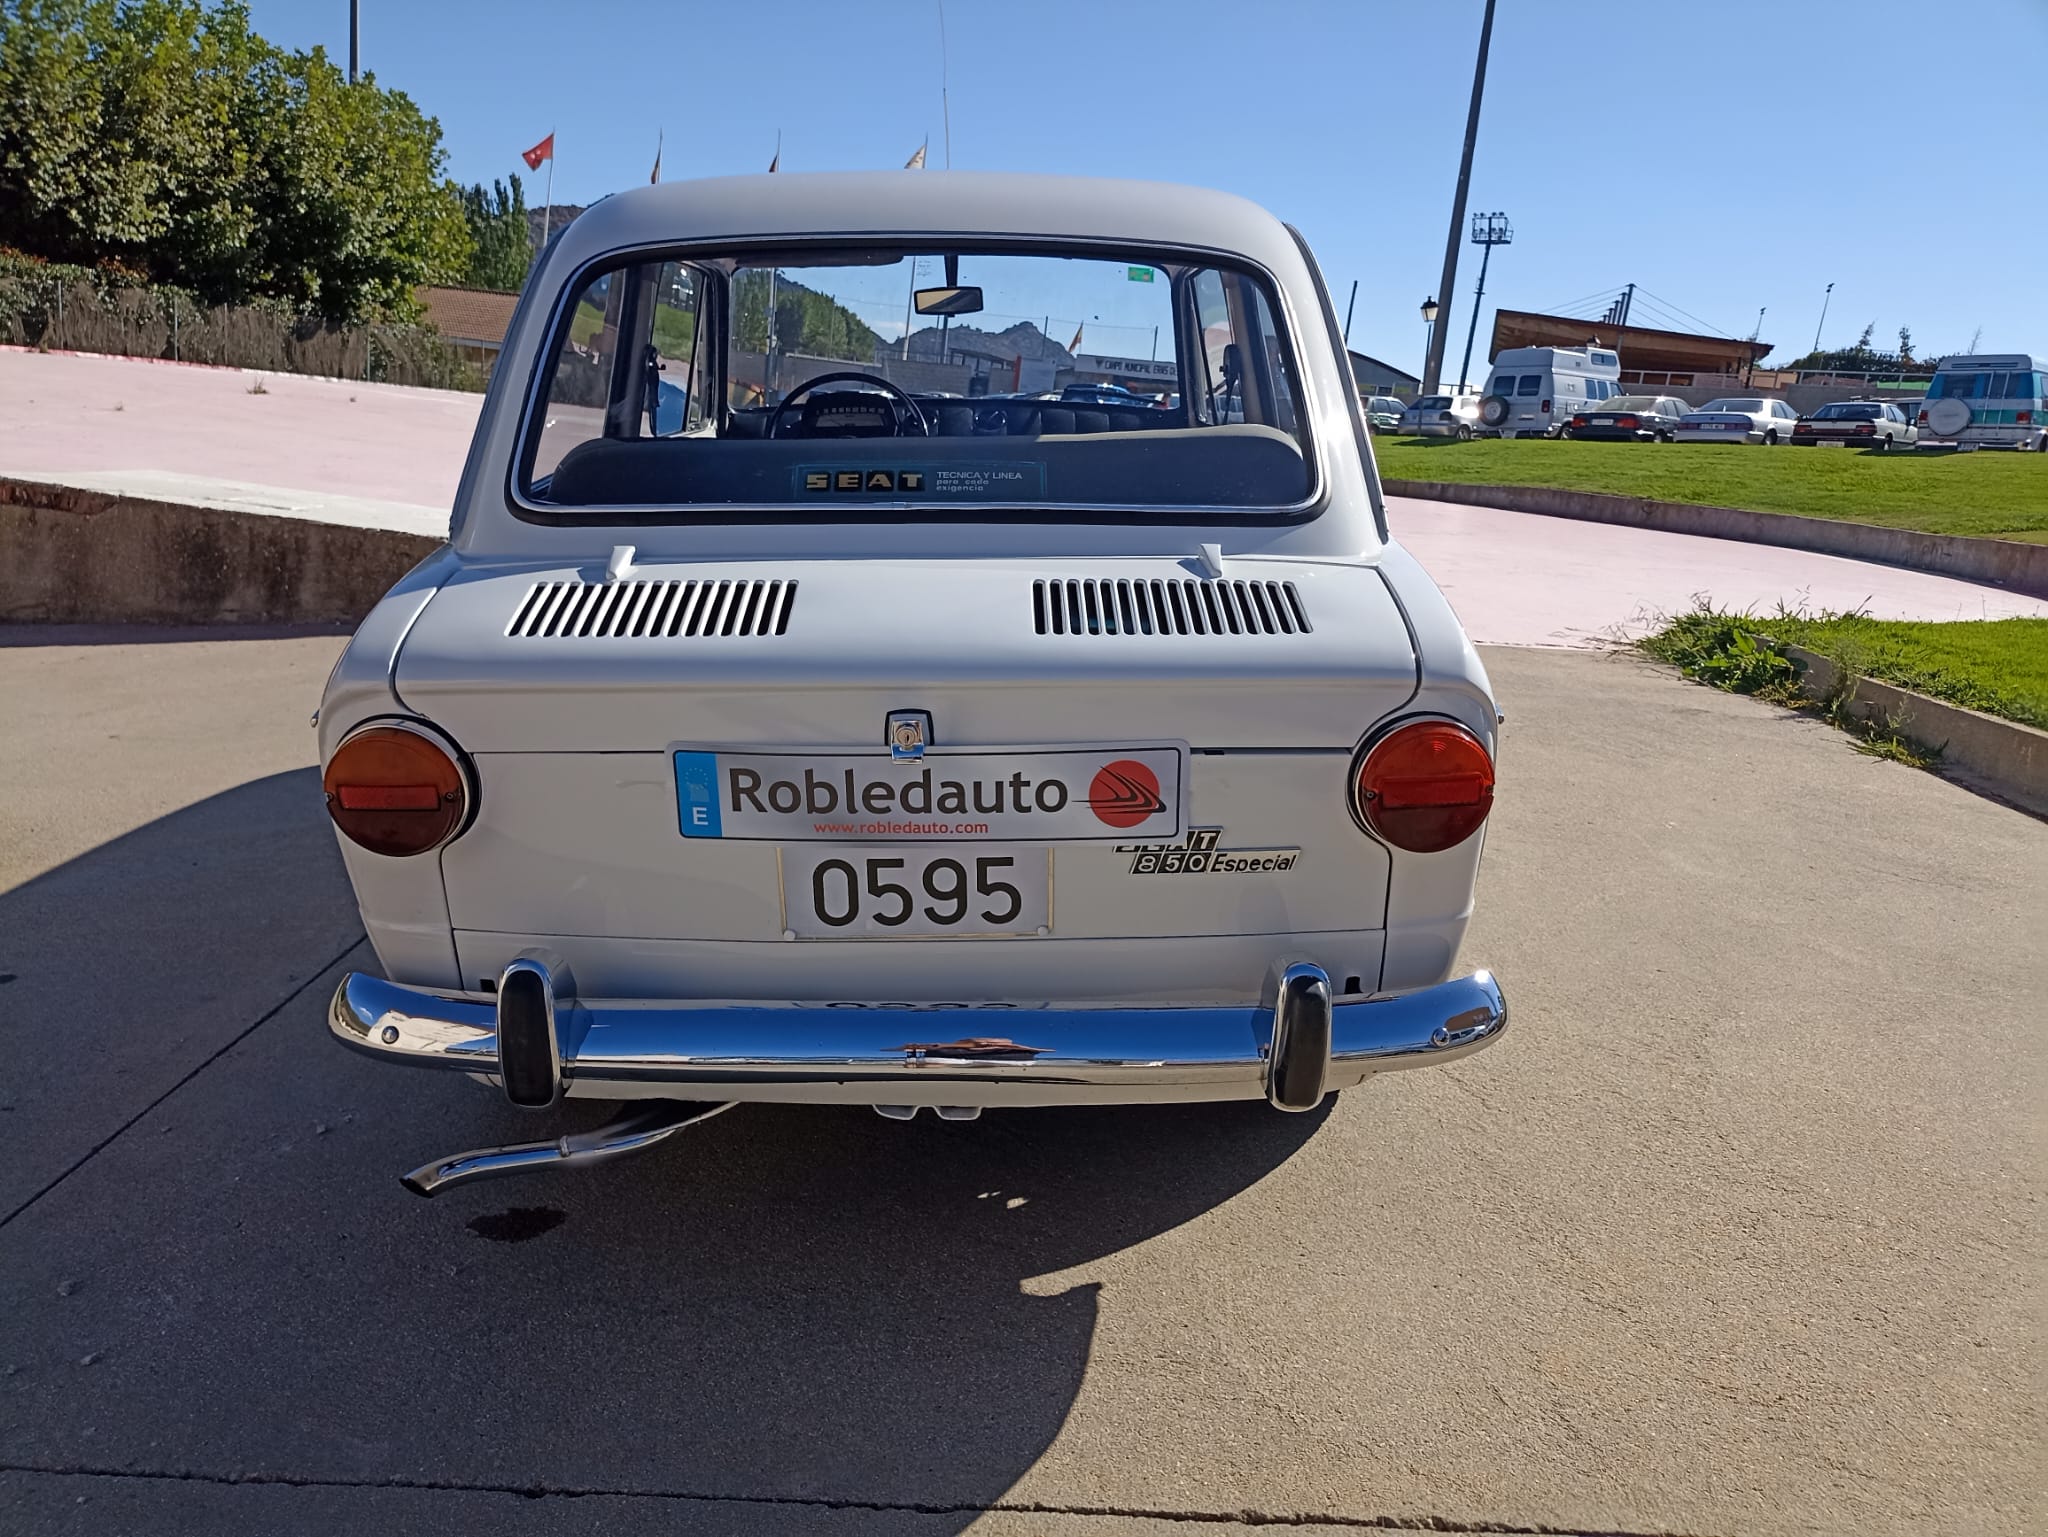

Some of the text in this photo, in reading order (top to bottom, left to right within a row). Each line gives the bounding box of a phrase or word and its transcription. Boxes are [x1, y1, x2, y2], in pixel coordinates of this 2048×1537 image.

[806, 473, 923, 489] SEAT
[936, 471, 1023, 480] TECNICA Y LINEA
[936, 484, 984, 493] exigencia
[729, 768, 1068, 814] Robledauto
[692, 806, 709, 826] E
[813, 821, 989, 833] www.robledauto.com
[1138, 853, 1297, 872] 850 Especial
[812, 856, 1022, 927] 0595
